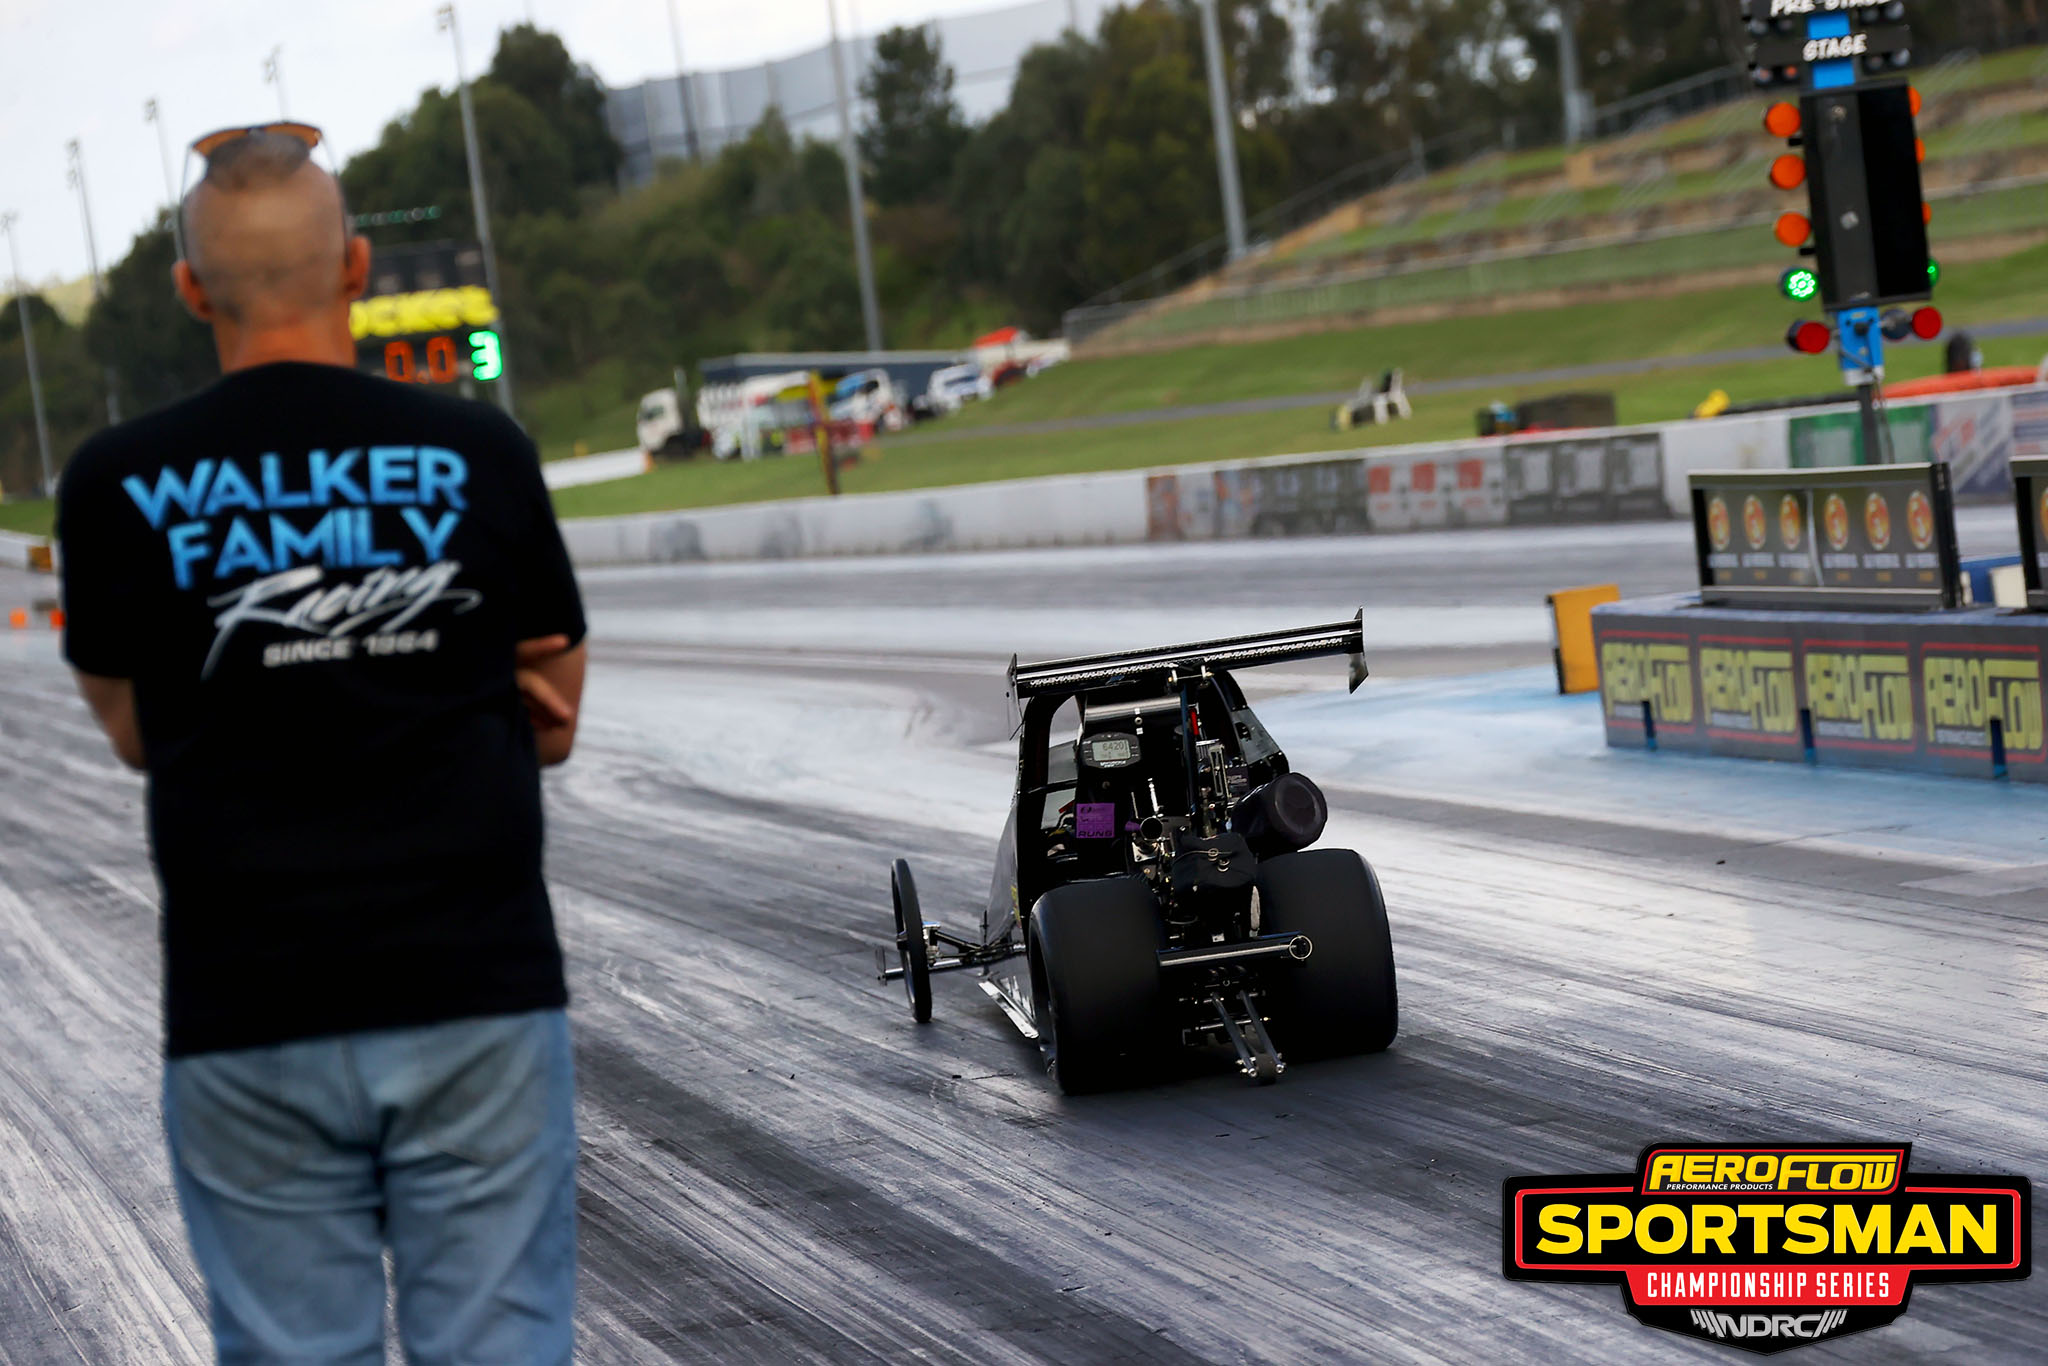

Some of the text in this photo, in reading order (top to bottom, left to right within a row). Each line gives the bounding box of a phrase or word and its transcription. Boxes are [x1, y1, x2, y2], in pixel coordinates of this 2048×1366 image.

[1770, 0, 1891, 17] PRE-S
[1803, 34, 1867, 61] STAGE
[121, 445, 469, 530] WALKER
[167, 507, 460, 590] FAMILY
[263, 638, 352, 668] SINCE
[1923, 658, 2043, 750] AEROFLOW
